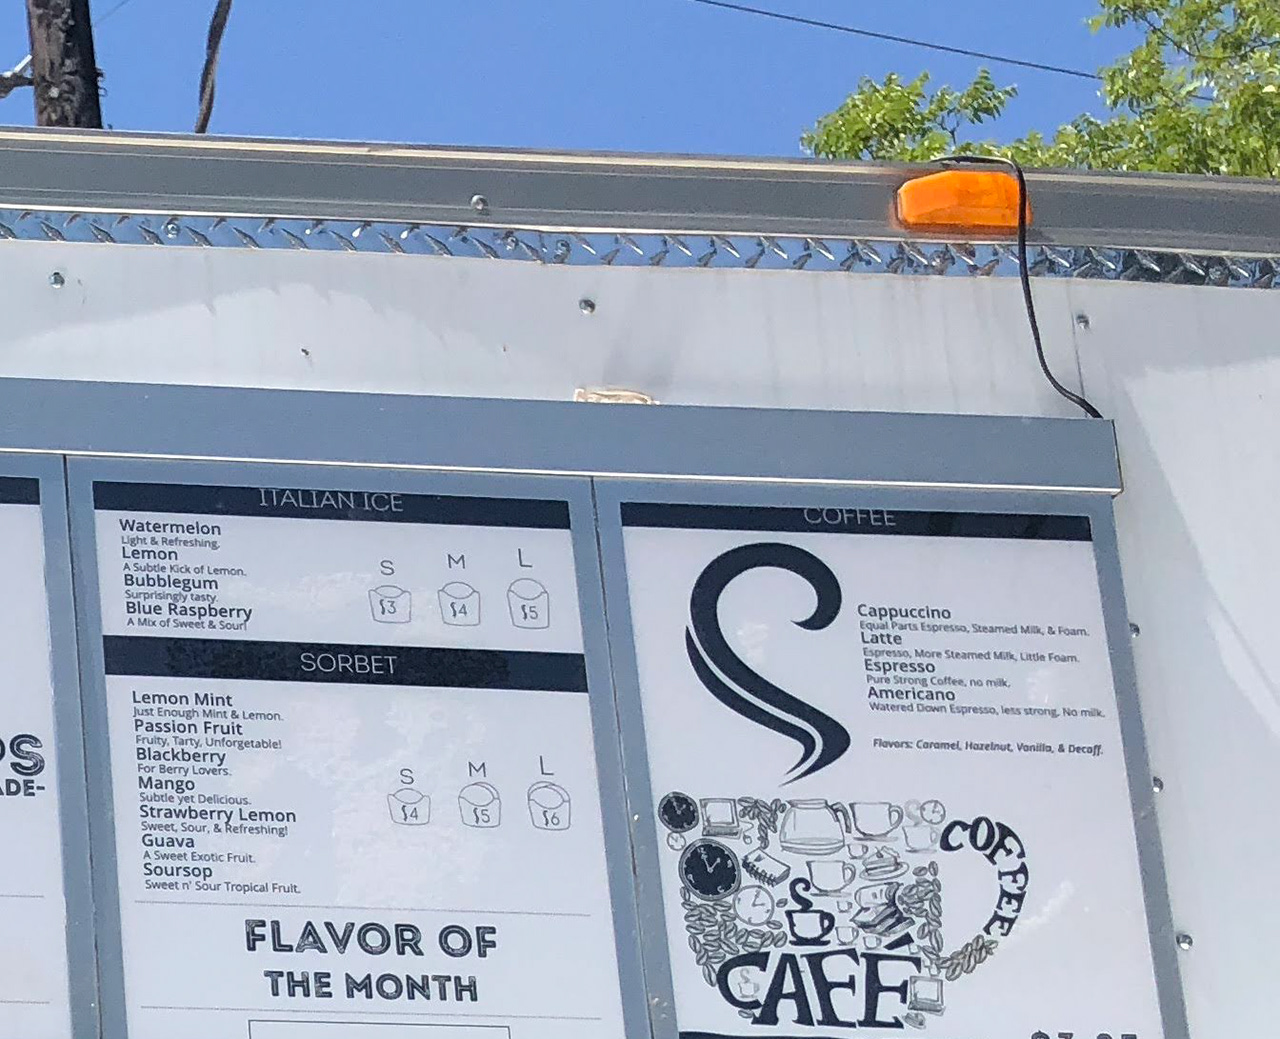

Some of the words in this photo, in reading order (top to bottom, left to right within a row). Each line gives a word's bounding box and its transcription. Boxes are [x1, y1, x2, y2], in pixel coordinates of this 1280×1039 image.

[259, 488, 354, 508] ITALIAN
[363, 492, 403, 511] ICE
[803, 507, 897, 526] COFFEE
[118, 518, 221, 535] Watermelon
[122, 546, 177, 560] Lemon
[380, 559, 394, 575] S
[124, 573, 218, 592] Bubblegum
[126, 600, 162, 615] Blue
[168, 602, 252, 624] Raspberry
[857, 603, 951, 621] Cappuccino
[860, 631, 902, 645] Latte
[300, 652, 397, 673] SORBET
[864, 658, 935, 675] Espresso
[867, 686, 955, 701] Americano
[139, 804, 233, 827] Strawberry
[238, 807, 296, 822] Lemon
[141, 820, 177, 832] Sweet,
[180, 821, 209, 833] Sour,
[213, 823, 222, 833] &
[224, 822, 287, 837] Refreshing!
[940, 816, 1029, 937] COFFEE
